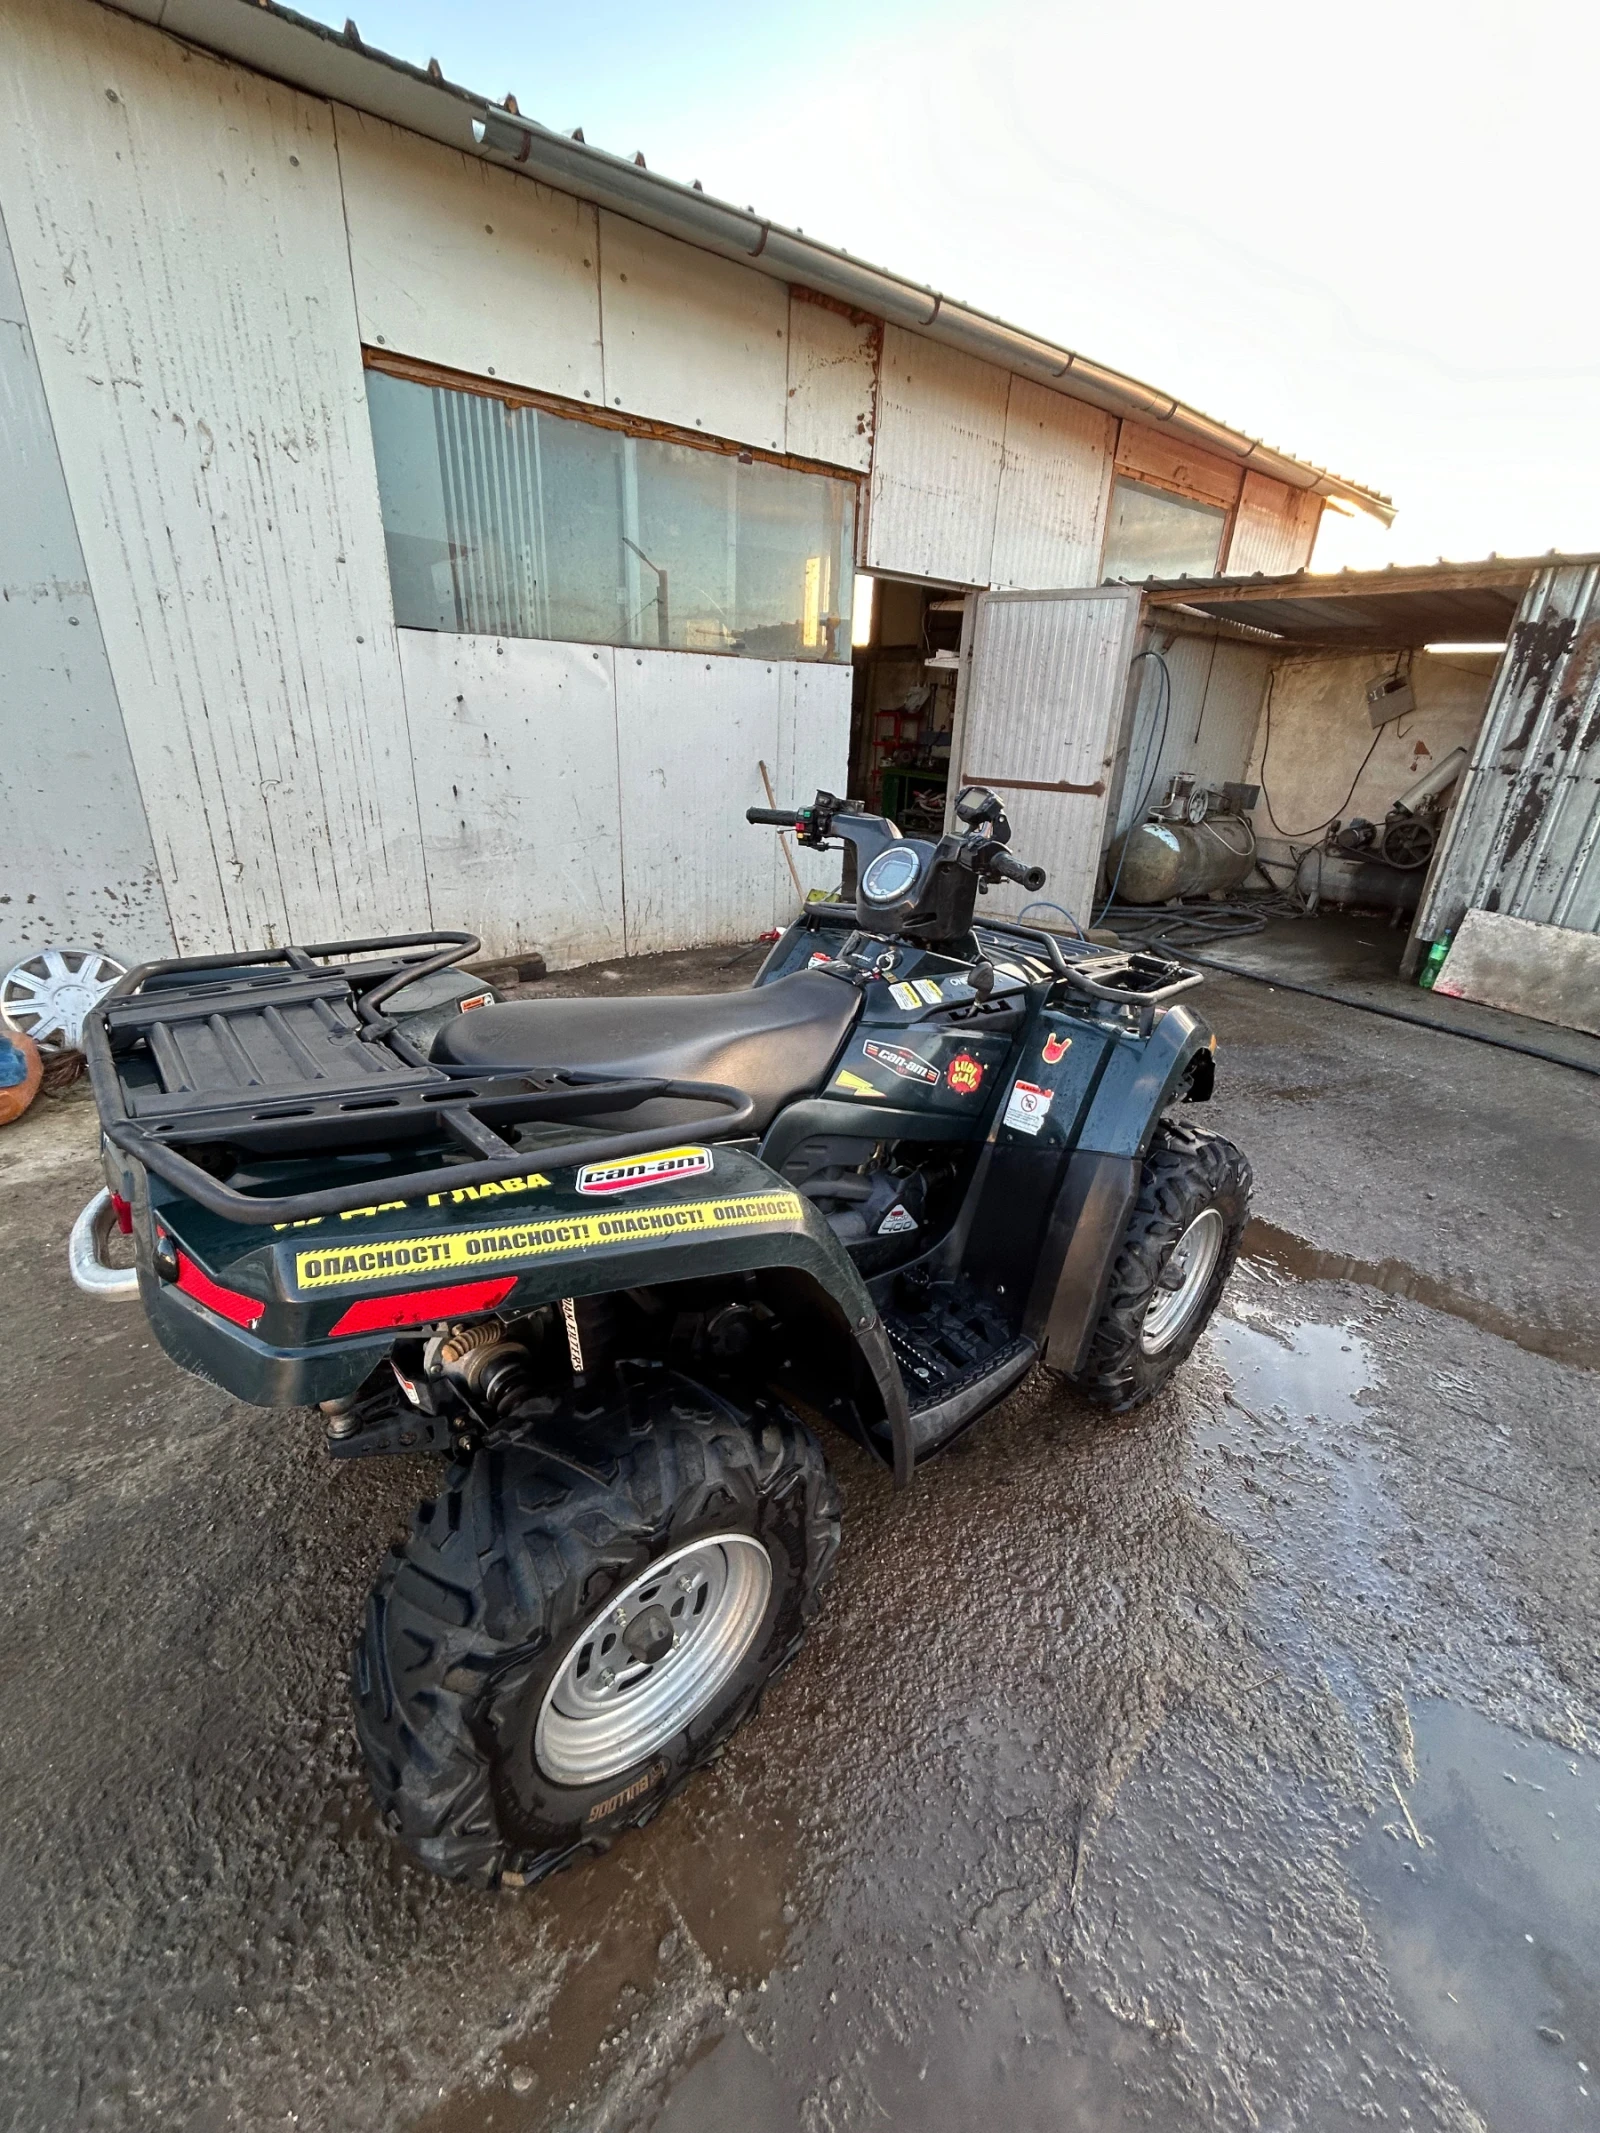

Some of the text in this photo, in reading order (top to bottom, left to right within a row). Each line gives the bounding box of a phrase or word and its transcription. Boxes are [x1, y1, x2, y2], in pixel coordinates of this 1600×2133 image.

[878, 1049, 928, 1078] can-am
[954, 1060, 978, 1077] LUDI
[584, 1153, 705, 1184] can-am
[427, 1173, 551, 1207] ГЛАВА
[304, 1201, 800, 1279] ОПАСНОСТ! ОПАСНОСТ! ОПАСНОСТ! ОПАСНОСТ!
[567, 1322, 582, 1371] FILTERS
